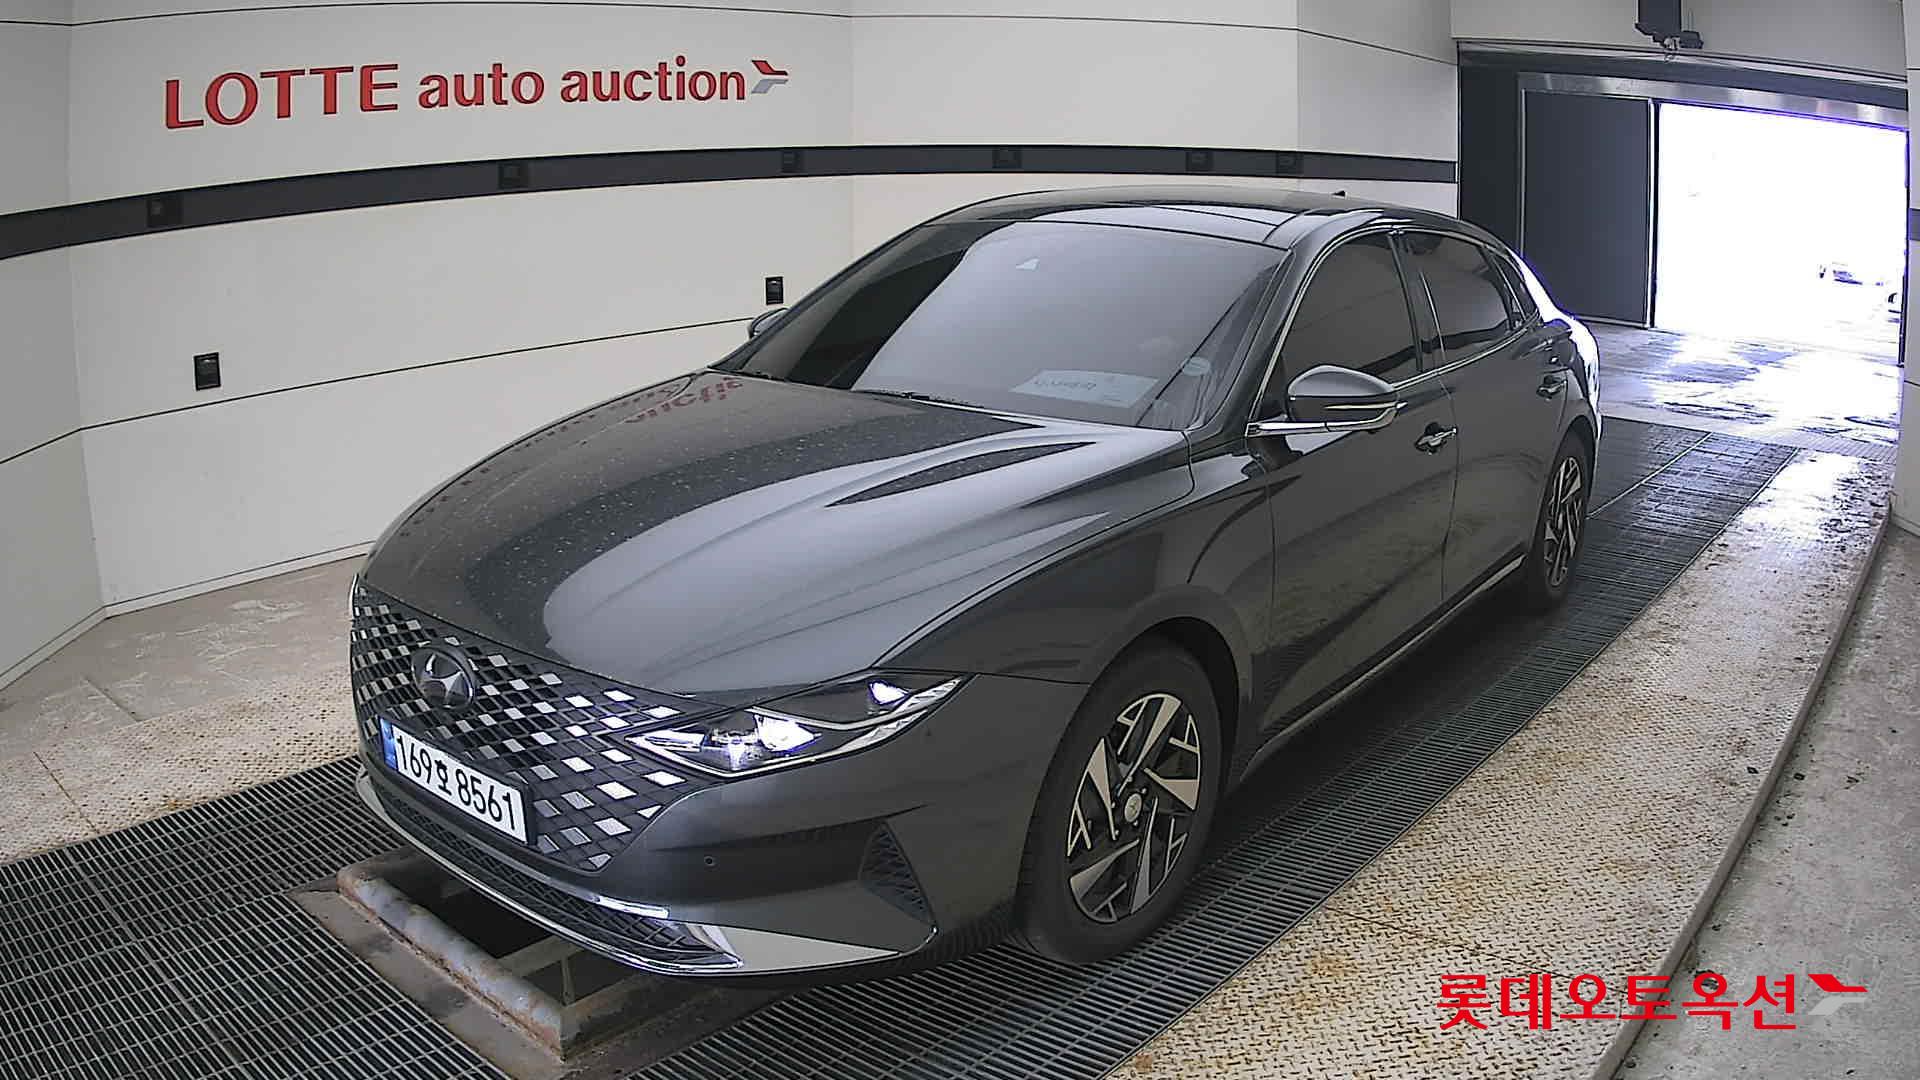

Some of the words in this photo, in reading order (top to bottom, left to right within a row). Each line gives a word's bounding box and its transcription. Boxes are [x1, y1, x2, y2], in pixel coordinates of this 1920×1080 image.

[165, 63, 398, 129] LOTTE
[418, 63, 546, 109] auto
[560, 55, 747, 103] auction
